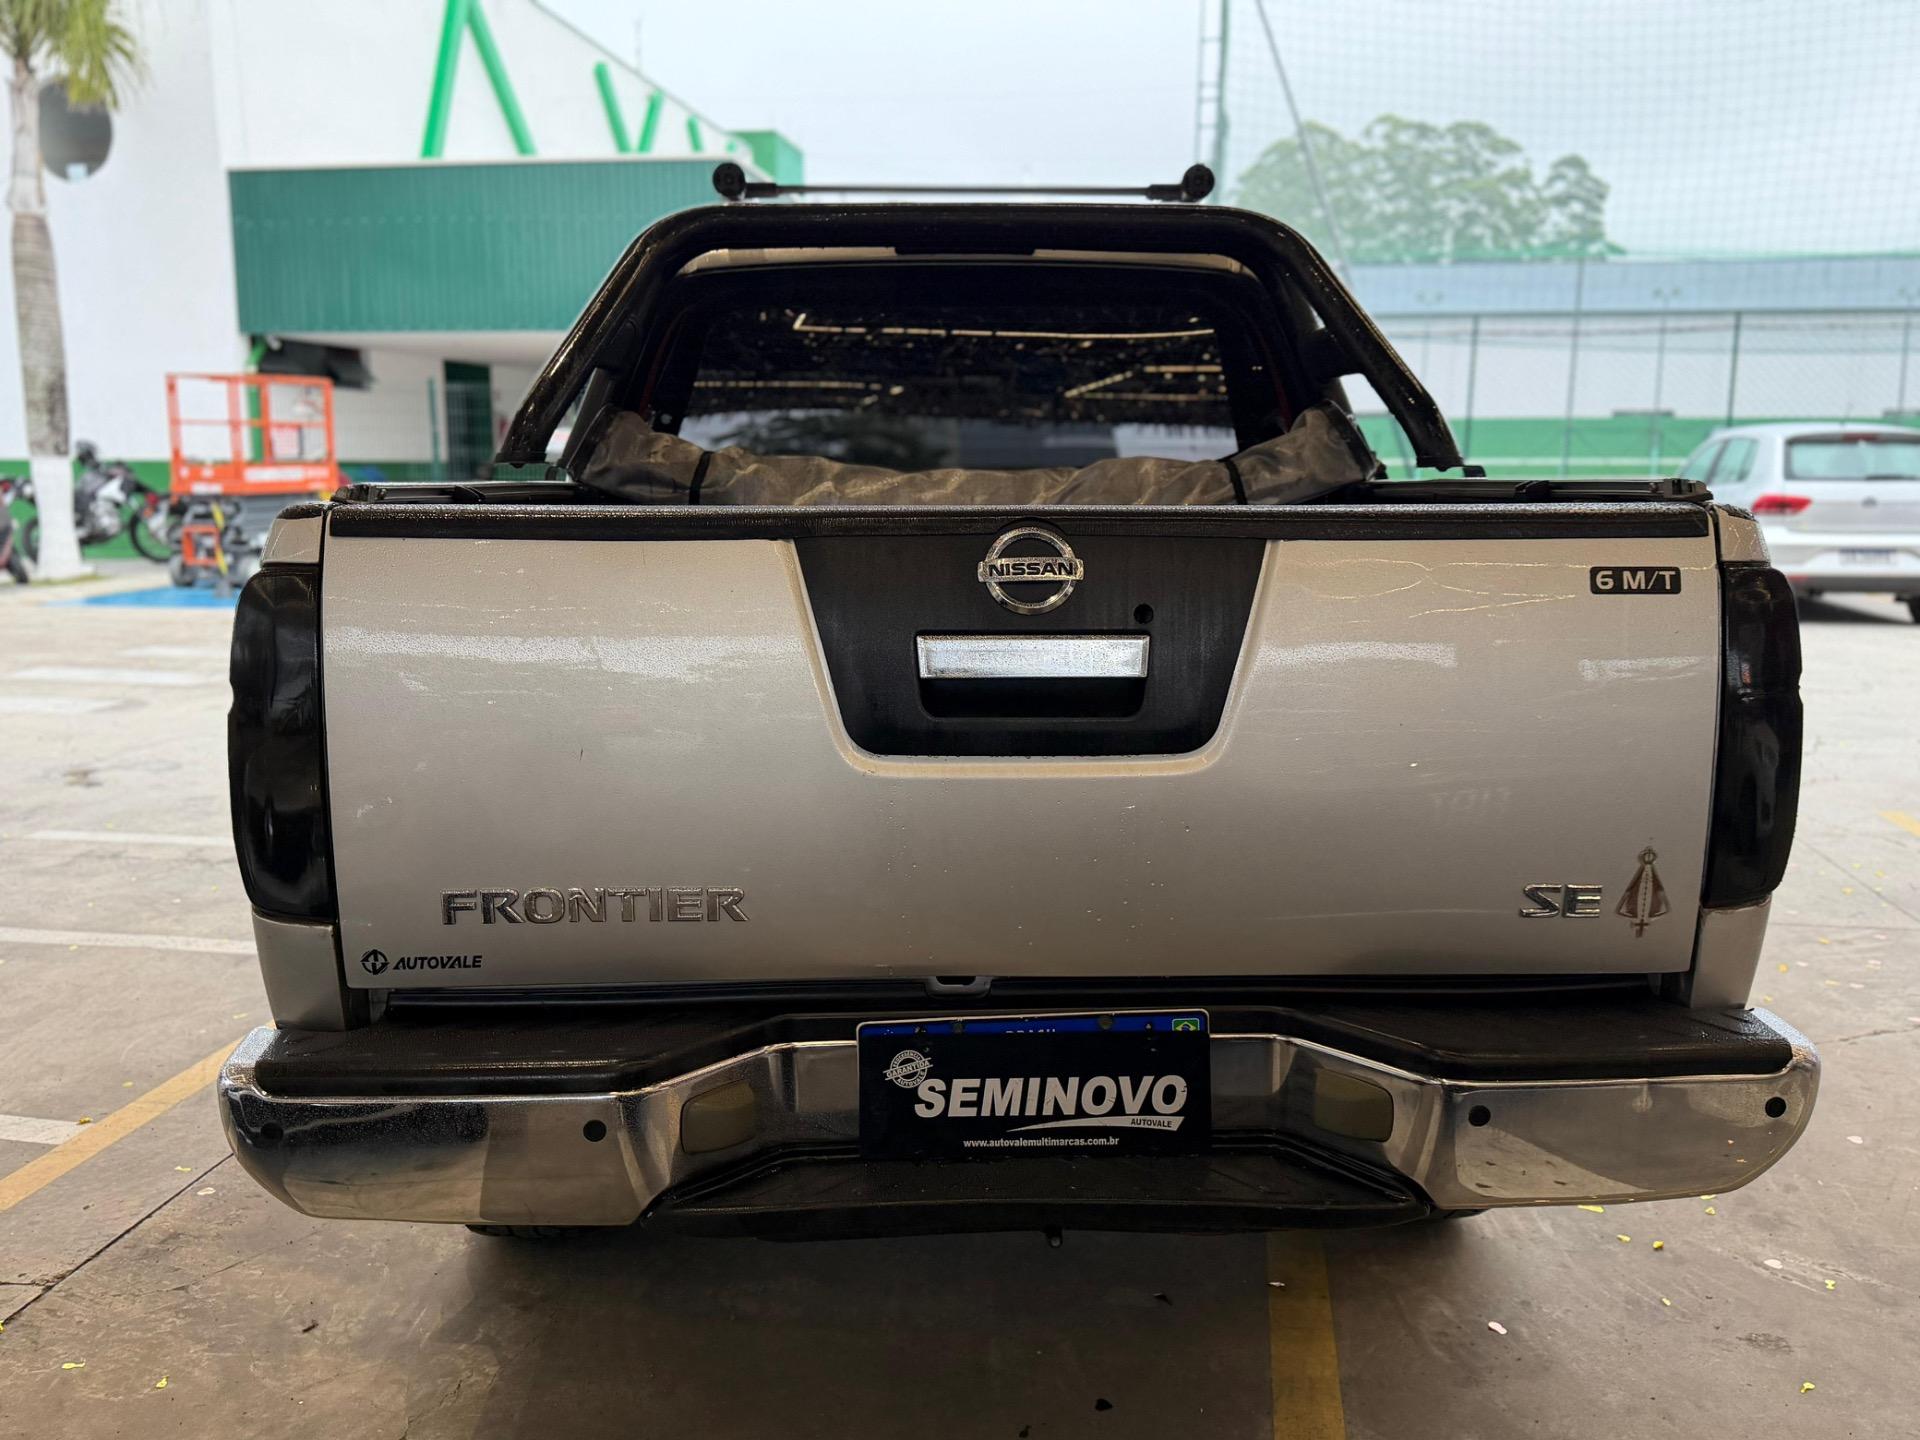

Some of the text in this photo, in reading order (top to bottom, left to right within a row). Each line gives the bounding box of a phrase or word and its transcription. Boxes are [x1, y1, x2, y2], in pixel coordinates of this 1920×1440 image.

[988, 562, 1074, 577] NISSAN
[1595, 570, 1676, 590] 6 M/T
[439, 887, 750, 925] FRONTIER
[1519, 883, 1603, 918] SE
[392, 955, 483, 970] AUTOVALE
[886, 1060, 930, 1078] GARANTIDA
[914, 1074, 1188, 1119] SEMINOVO
[1130, 1118, 1173, 1128] AUTOVALE
[962, 1136, 1120, 1148] www.autovalemultimarcas.com.br
